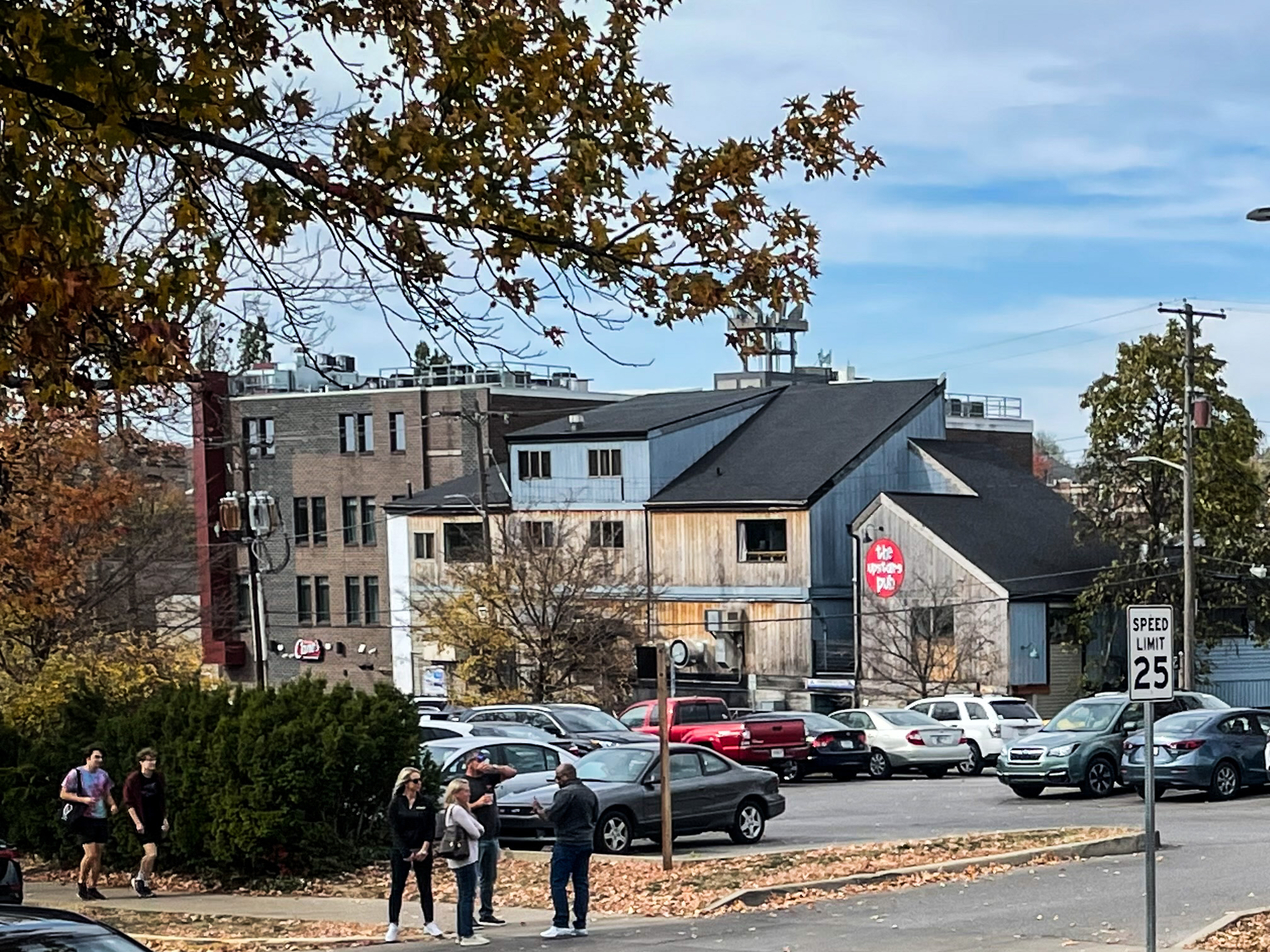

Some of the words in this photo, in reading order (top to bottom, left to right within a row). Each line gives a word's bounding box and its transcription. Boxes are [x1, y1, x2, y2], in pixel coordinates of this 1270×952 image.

[875, 544, 893, 561] the
[876, 574, 896, 593] pub
[1133, 617, 1169, 632] SPEED
[1137, 637, 1165, 651] LIMIT
[1134, 656, 1169, 690] 25
